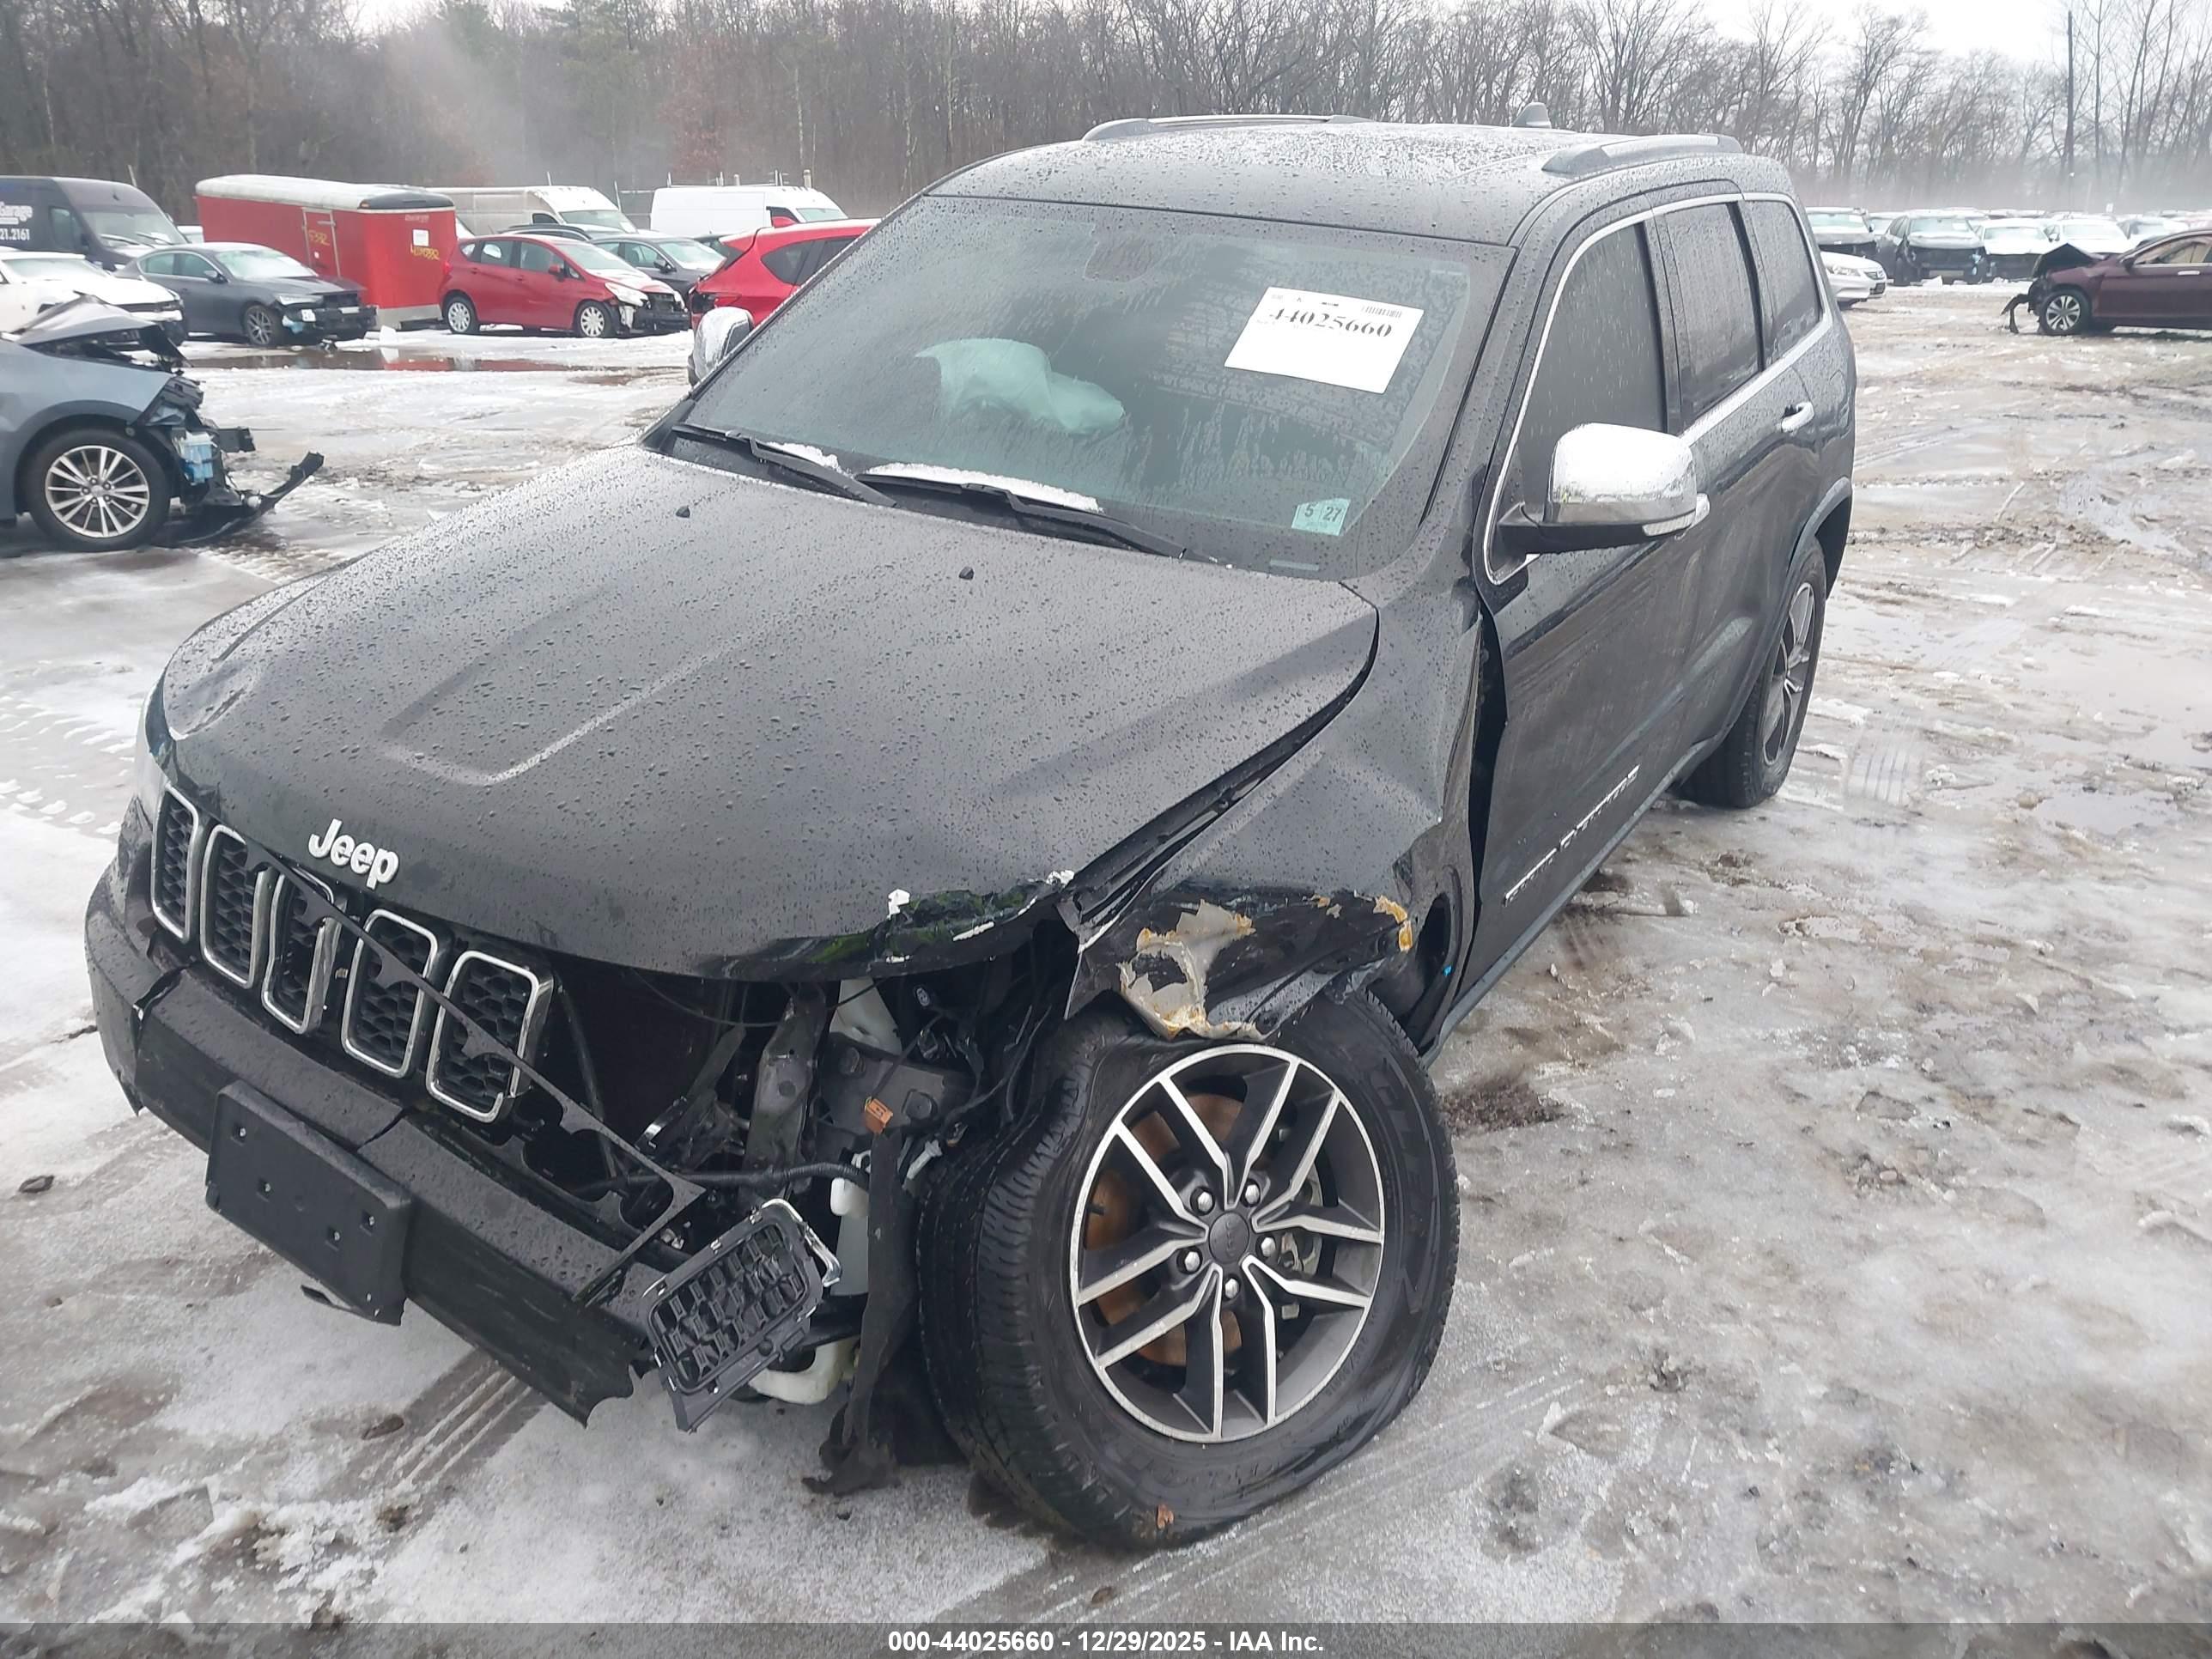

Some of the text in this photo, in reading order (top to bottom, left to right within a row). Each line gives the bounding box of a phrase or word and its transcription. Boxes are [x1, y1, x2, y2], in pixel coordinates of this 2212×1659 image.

[1269, 308, 1392, 337] 44025660
[1304, 501, 1343, 522] 5 27
[308, 818, 400, 890] Jeep
